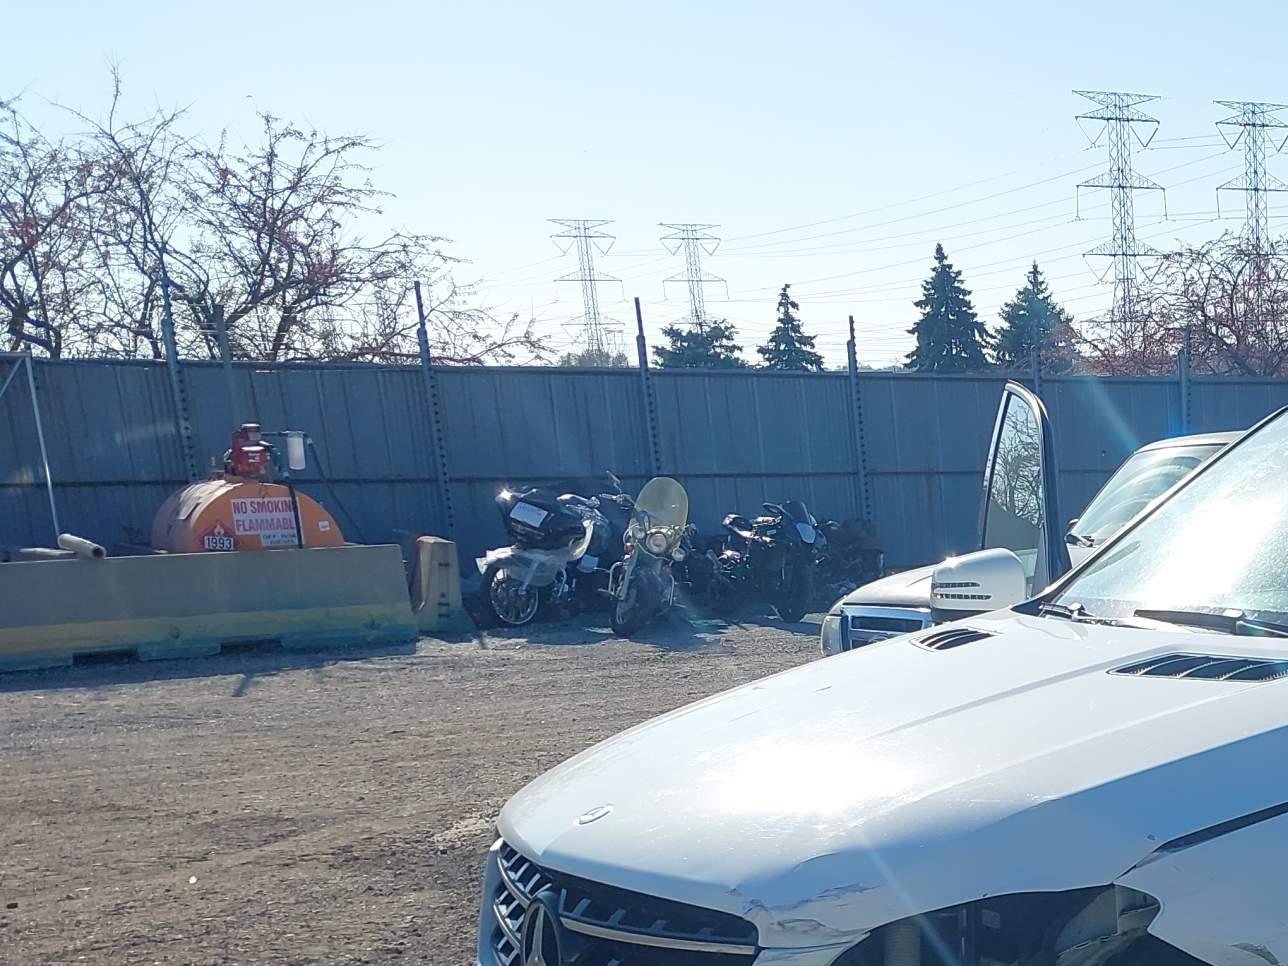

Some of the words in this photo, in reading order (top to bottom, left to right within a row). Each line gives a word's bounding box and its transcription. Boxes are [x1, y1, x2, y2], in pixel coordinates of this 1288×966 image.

[232, 501, 248, 515] NO
[250, 499, 294, 514] SMOKIN
[235, 517, 297, 532] FLAMMABL
[207, 537, 232, 550] 1993
